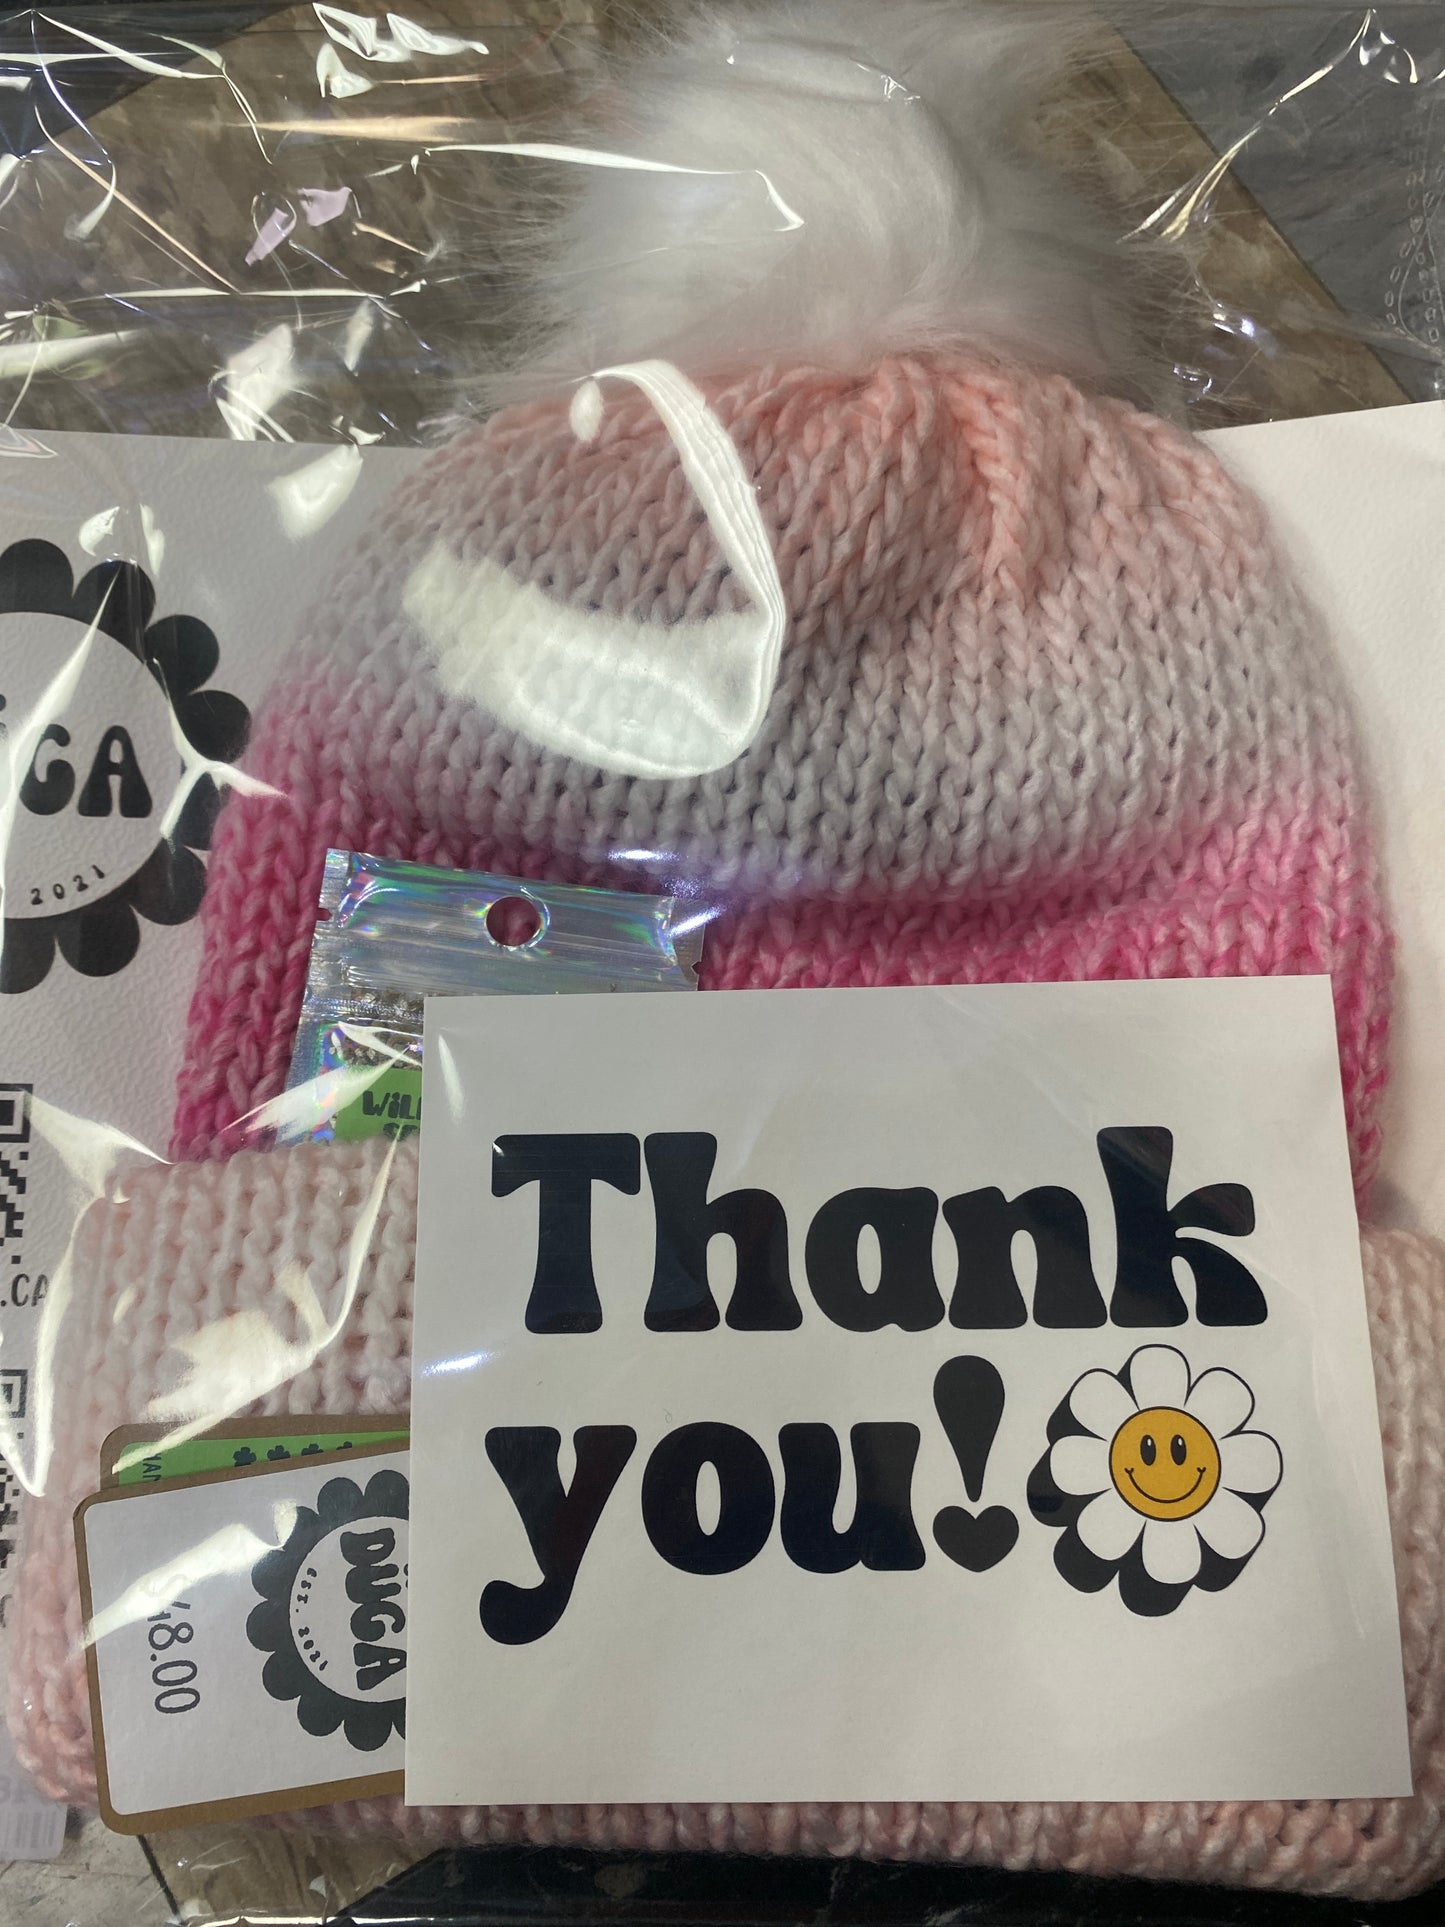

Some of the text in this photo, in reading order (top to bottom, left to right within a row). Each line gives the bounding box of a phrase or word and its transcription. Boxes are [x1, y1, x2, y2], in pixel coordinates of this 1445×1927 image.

[0, 718, 153, 819] GA
[30, 864, 106, 906] 2021
[491, 1126, 1268, 1335] Thank
[479, 1355, 1020, 1646] you!
[297, 1626, 329, 1672] 2021
